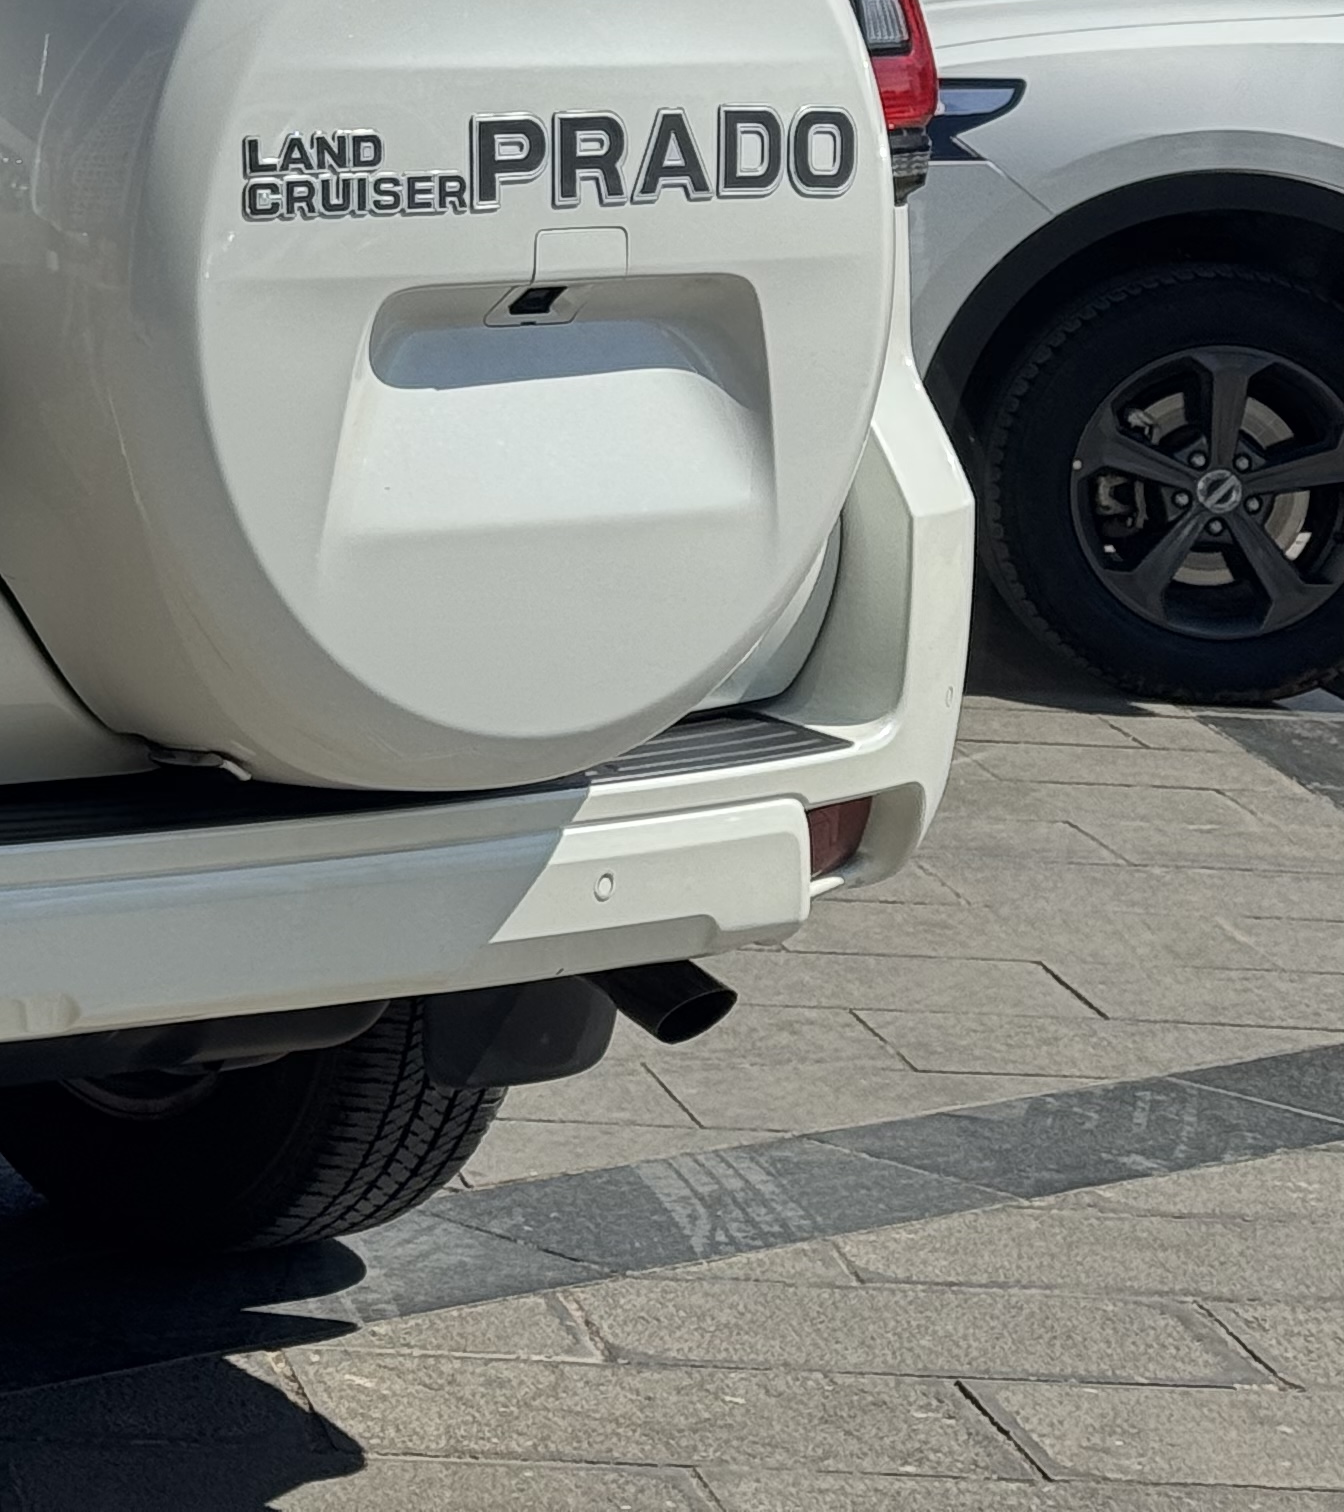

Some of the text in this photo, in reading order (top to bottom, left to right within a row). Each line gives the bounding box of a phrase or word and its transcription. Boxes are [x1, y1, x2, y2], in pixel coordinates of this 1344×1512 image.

[242, 129, 384, 176] LAND
[469, 103, 859, 211] PRADO
[242, 170, 471, 221] CRUISER
